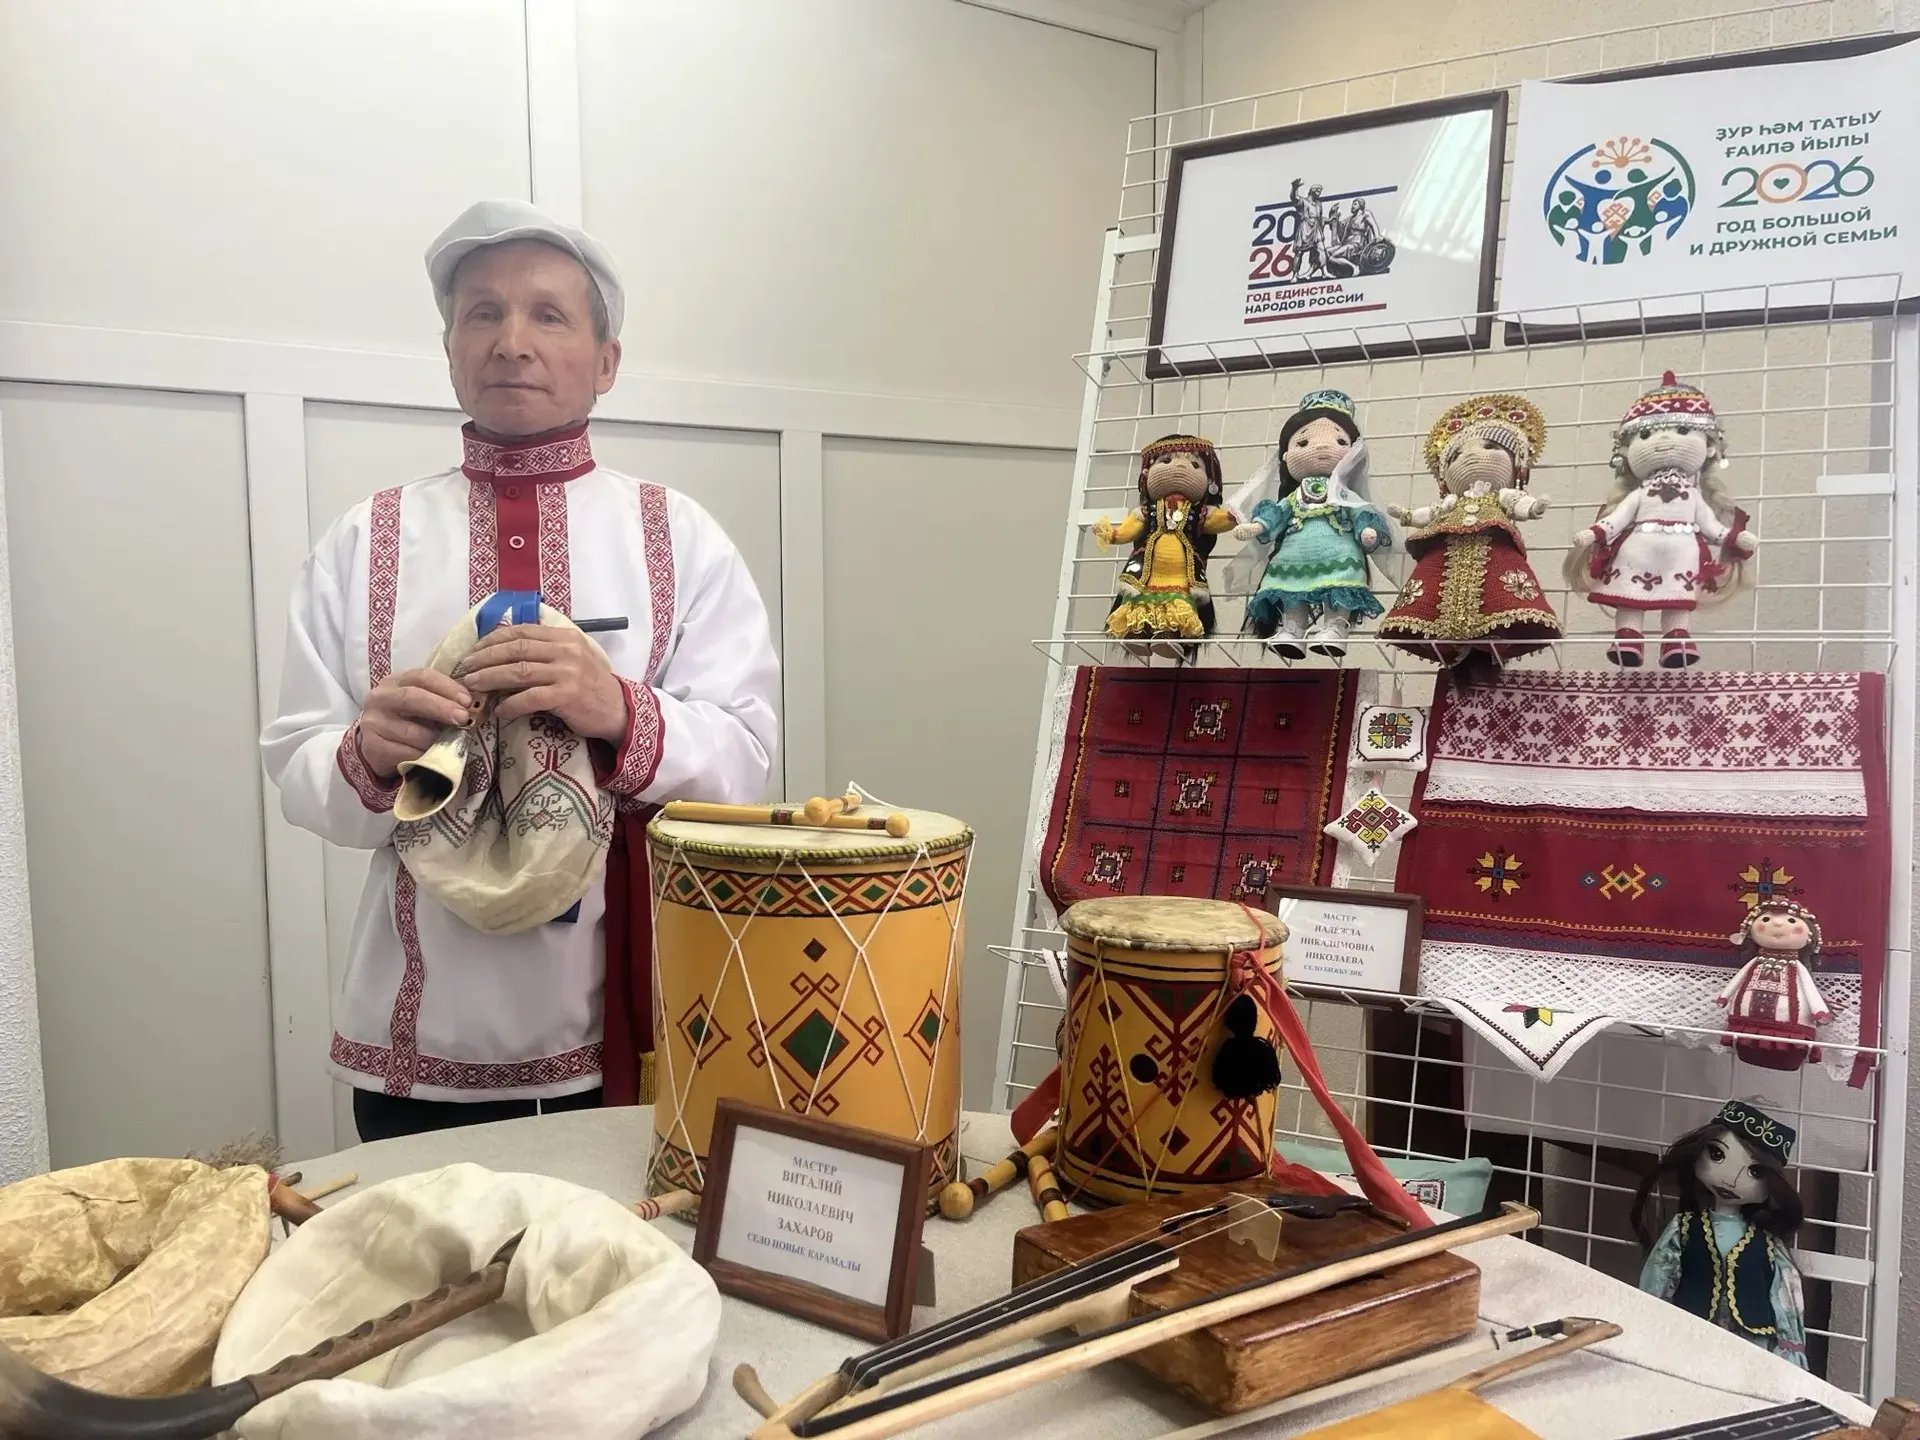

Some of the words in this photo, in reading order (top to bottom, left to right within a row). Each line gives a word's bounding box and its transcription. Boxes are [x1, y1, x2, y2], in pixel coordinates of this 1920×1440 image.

[1809, 110, 1882, 131] ТАТЫУ
[1801, 132, 1870, 151] ЙЫЛЫ
[1717, 155, 1875, 208] 2026
[1252, 210, 1300, 247] 20
[1716, 219, 1756, 234] ГОД
[1762, 206, 1872, 230] БОЛЬШОЙ
[1689, 243, 1704, 256] И
[1709, 232, 1817, 256] ДРУЖНОЙ
[1823, 225, 1898, 246] СЕМЬИ
[1248, 244, 1295, 280] 26
[1245, 299, 1305, 314] НАРОДОВ
[1309, 293, 1364, 307] РОССИИ
[1246, 292, 1271, 303] ГОД
[1275, 284, 1343, 300] ЕДИНСТВА
[1323, 912, 1357, 922] МАСТЕР
[1303, 964, 1323, 972] СЕЛО
[1305, 951, 1364, 965] НИКОЛАЕВА
[792, 1155, 838, 1176] МАСТЕР
[781, 1169, 843, 1196] ВИТАЛИЙ
[766, 1190, 855, 1224] НИКОЛАЕВИЧ
[777, 1217, 834, 1244] ЗАХАРОВ
[747, 1232, 771, 1246] СЕЛО
[772, 1239, 805, 1256] НОВЫЕ
[808, 1248, 861, 1273] КАРАМАЛЫ
